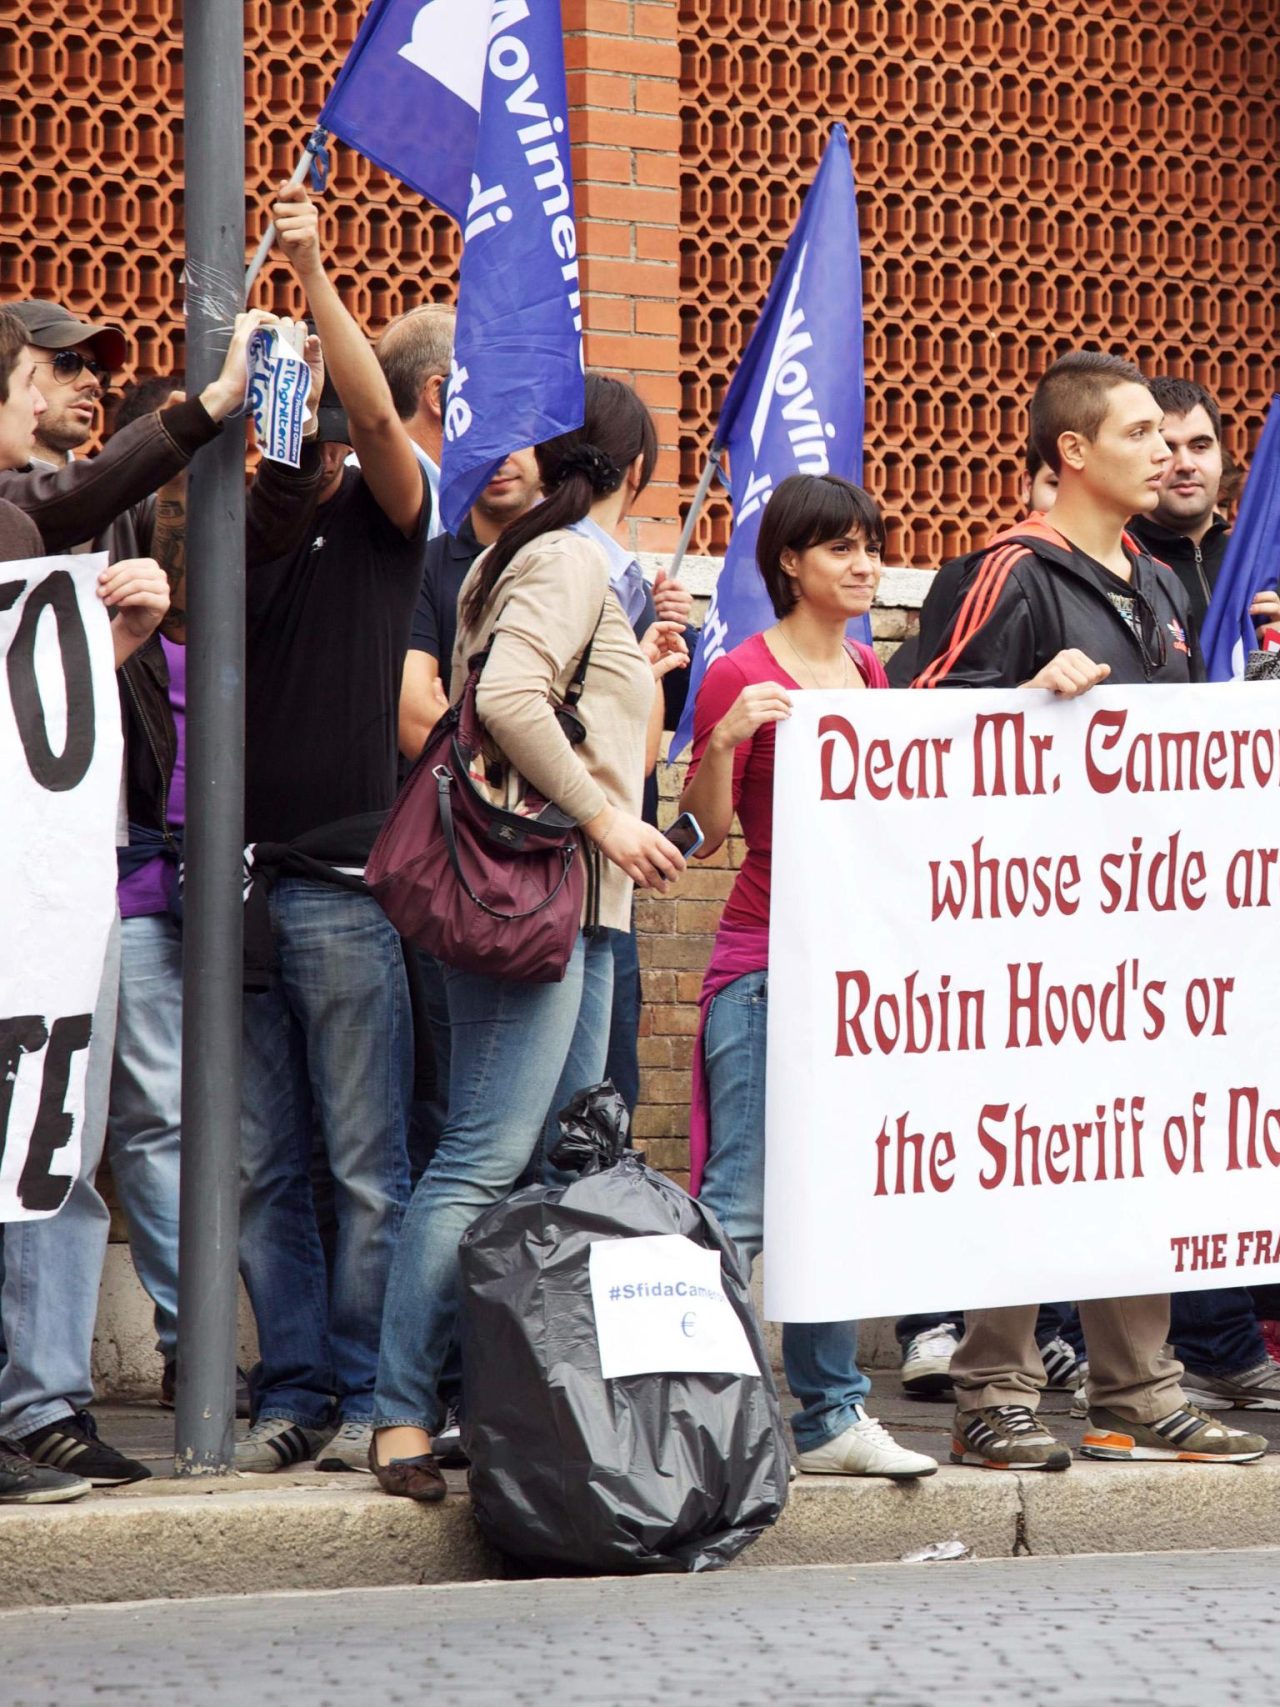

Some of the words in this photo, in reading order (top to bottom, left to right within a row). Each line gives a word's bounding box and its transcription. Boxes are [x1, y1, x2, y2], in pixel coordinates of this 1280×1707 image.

[818, 714, 952, 800] Dear
[973, 713, 1060, 798] Mr.
[929, 837, 1081, 921] whose
[1101, 832, 1207, 913] side
[835, 970, 985, 1057] Robin
[1006, 959, 1165, 1049] Hood's
[1186, 977, 1235, 1037] or
[874, 1112, 956, 1196] the
[978, 1096, 1145, 1190] Sheriff
[1164, 1093, 1206, 1175] of
[1170, 1233, 1227, 1272] THE
[680, 1311, 697, 1338] €
